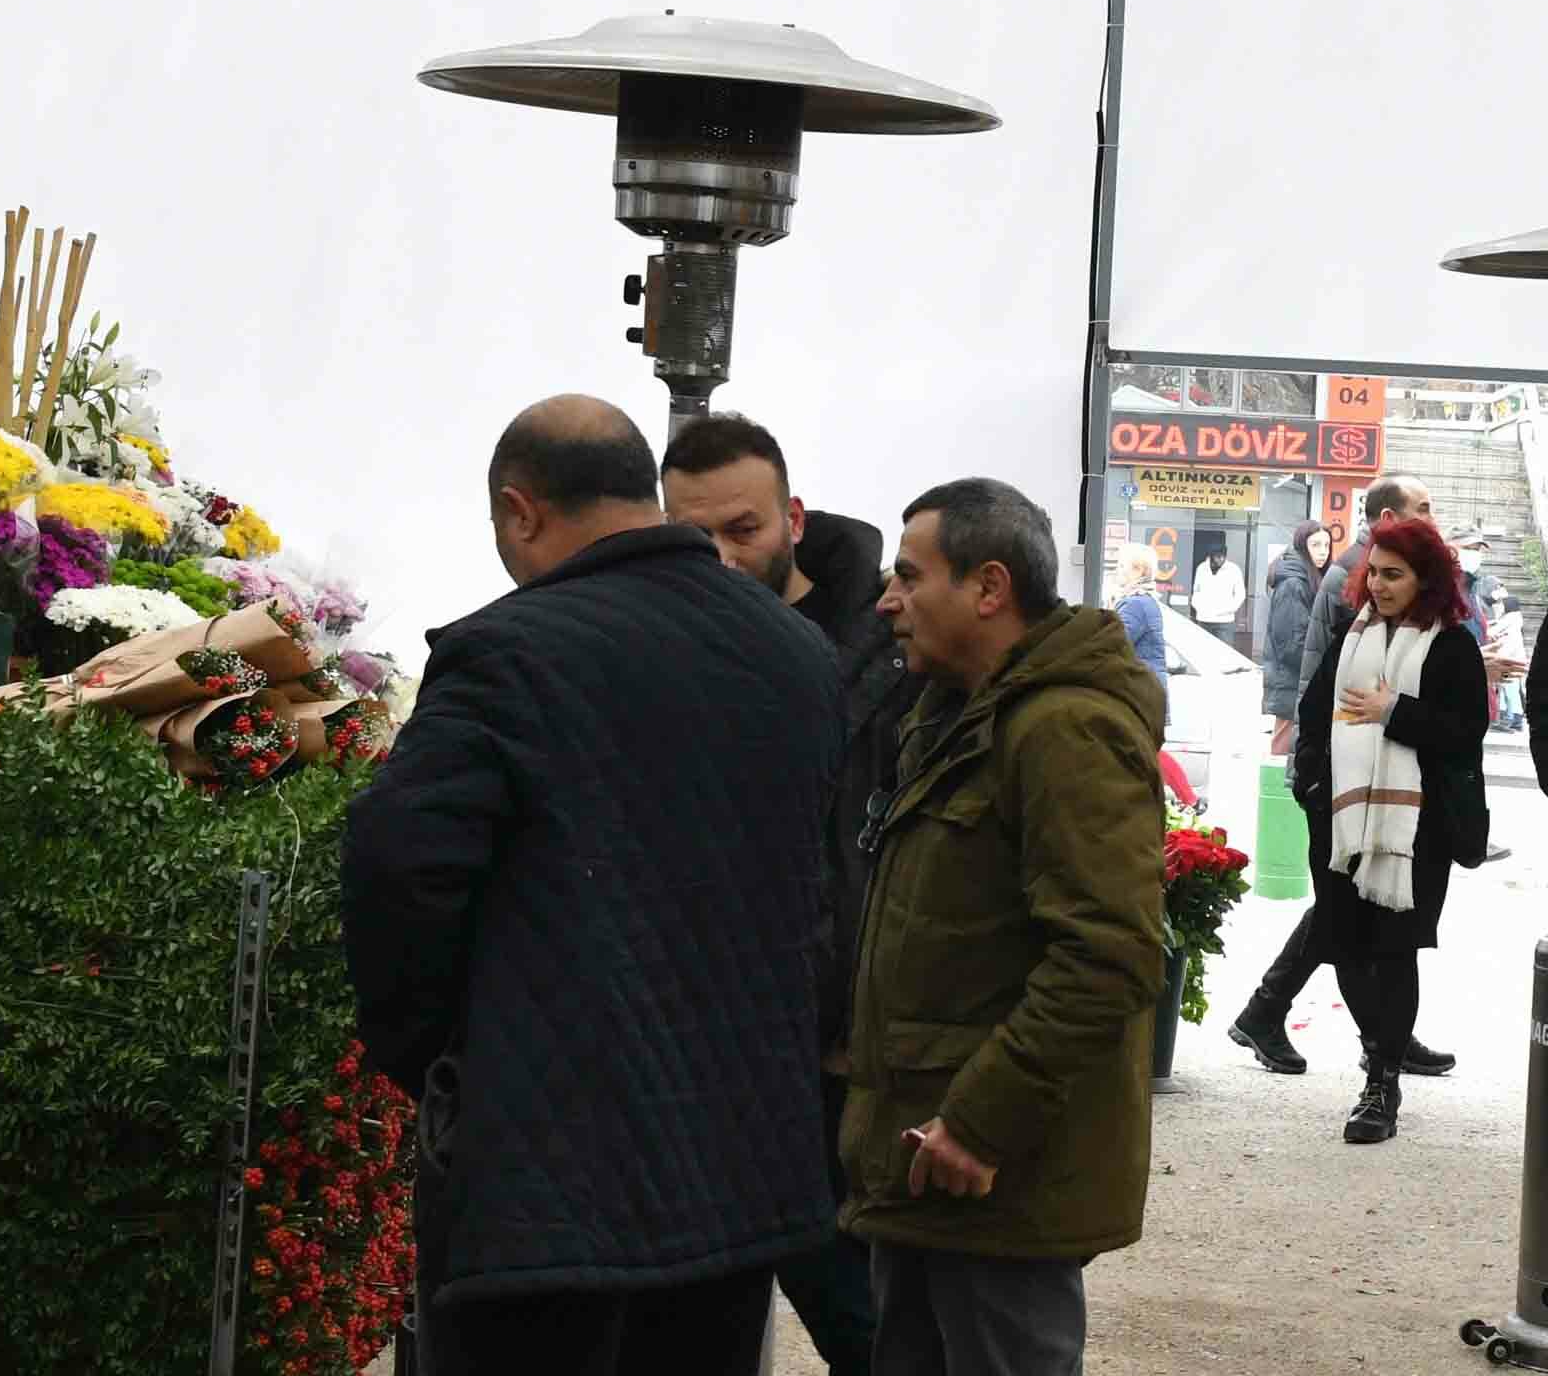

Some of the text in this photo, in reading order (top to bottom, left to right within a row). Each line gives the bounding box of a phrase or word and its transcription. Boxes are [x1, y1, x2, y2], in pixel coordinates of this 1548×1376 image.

[1339, 387, 1370, 406] 04
[1197, 423, 1308, 462] DÖVİZ
[1140, 470, 1253, 486] ALTINKOZA
[1209, 487, 1245, 497] ALTIN
